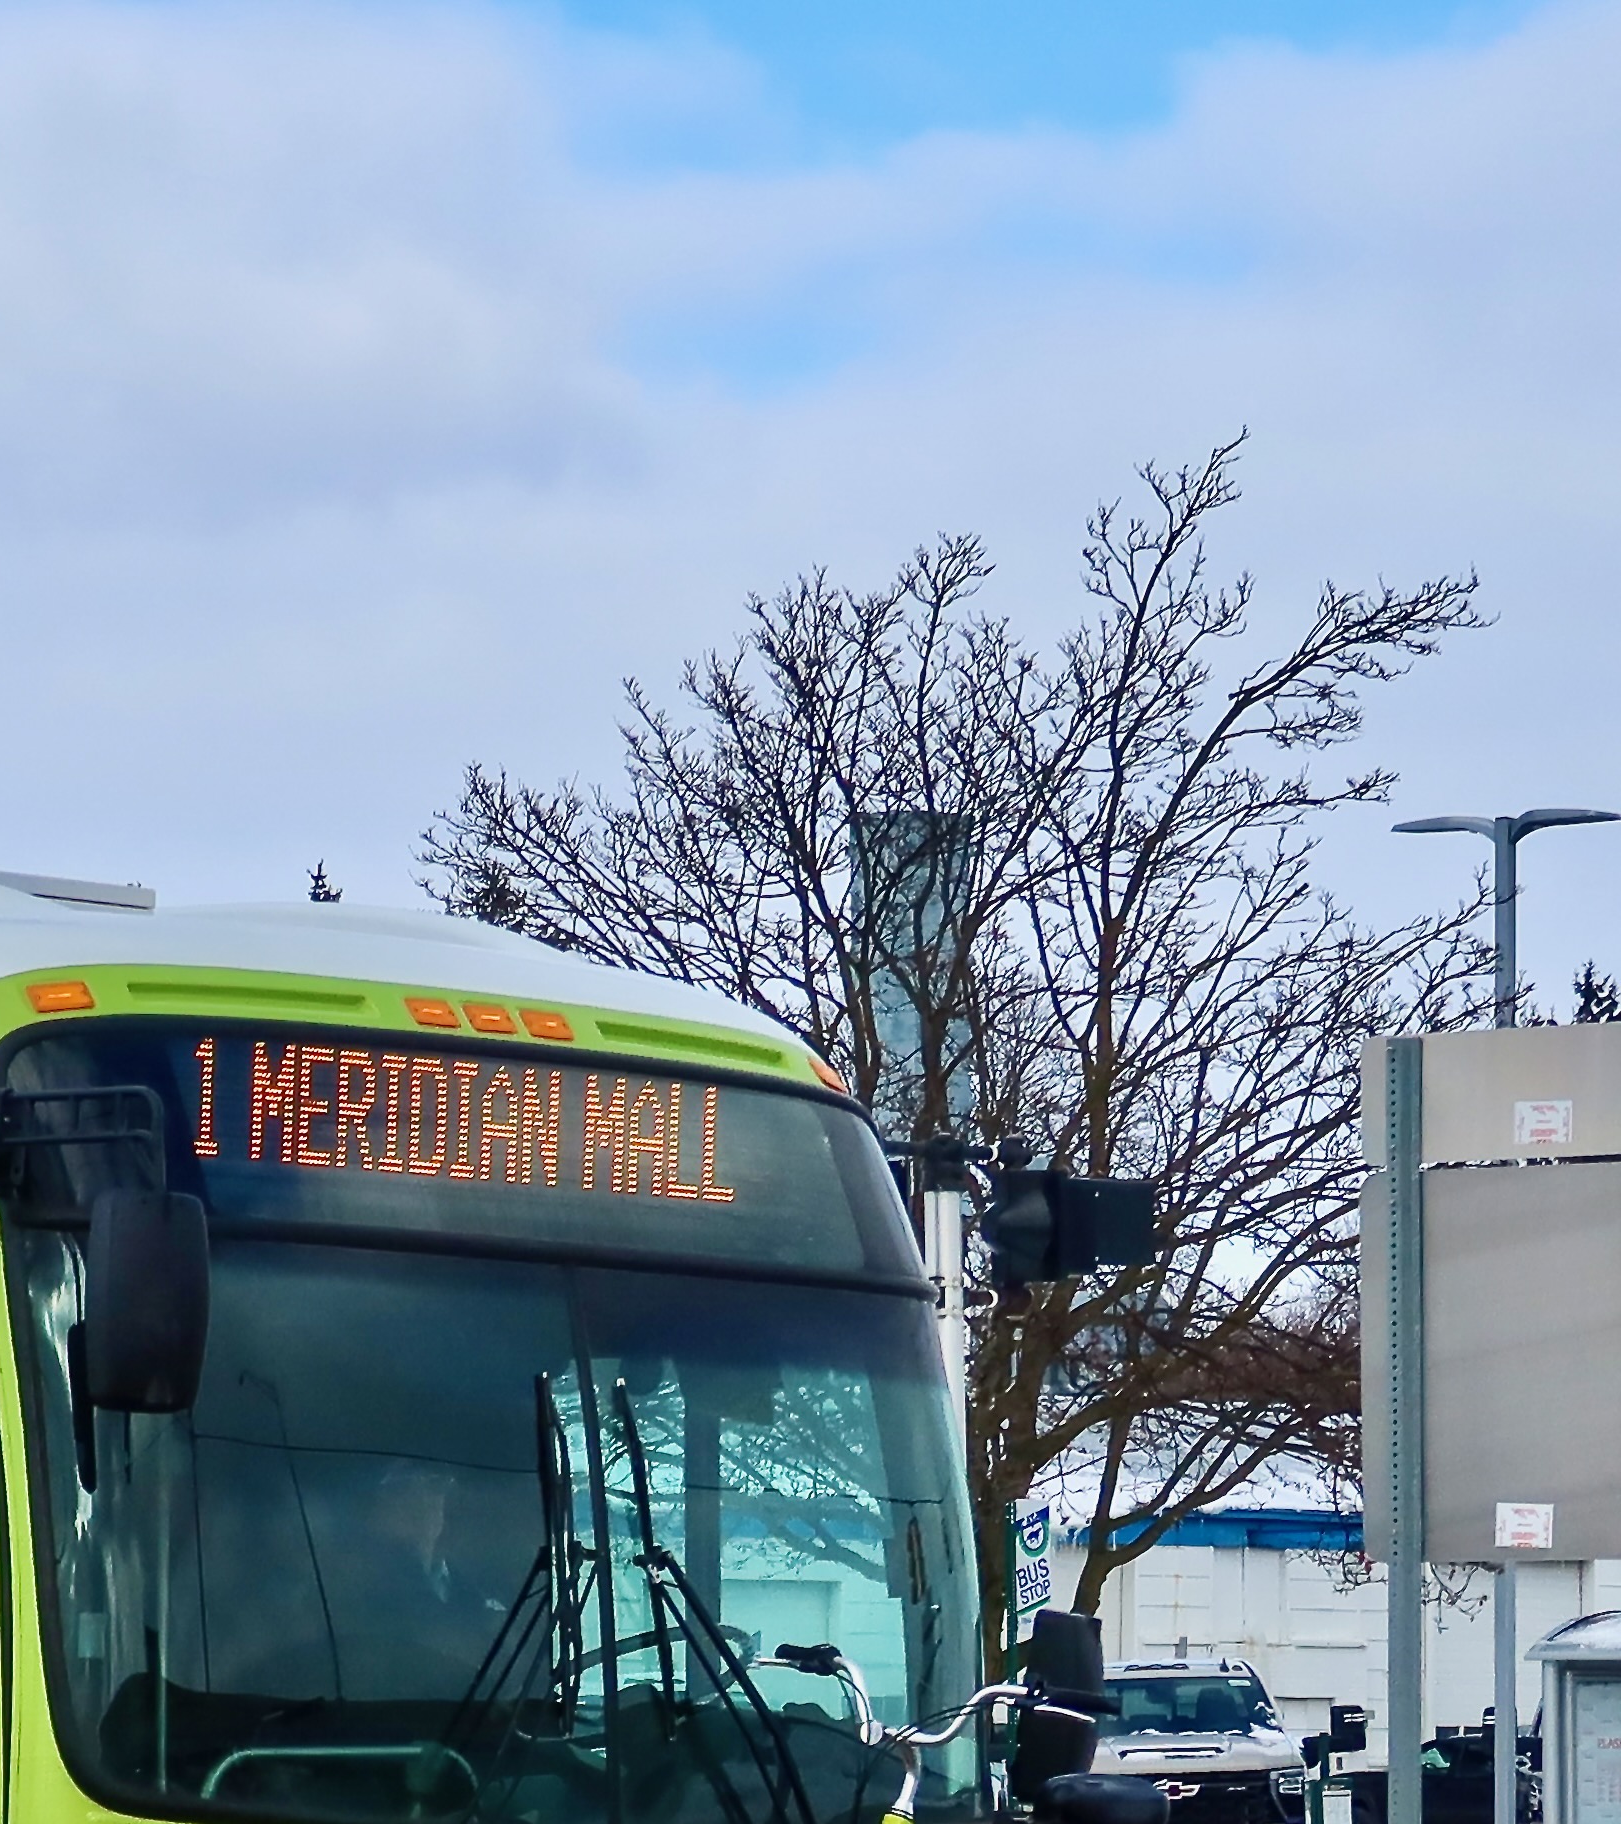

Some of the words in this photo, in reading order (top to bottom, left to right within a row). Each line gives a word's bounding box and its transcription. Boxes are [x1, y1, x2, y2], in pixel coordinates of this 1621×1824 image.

[193, 1038, 219, 1156] 1
[249, 1042, 561, 1187] MERIDIAN
[581, 1074, 735, 1202] MALL
[1016, 1558, 1049, 1589] BUS
[1020, 1579, 1051, 1605] STOP
